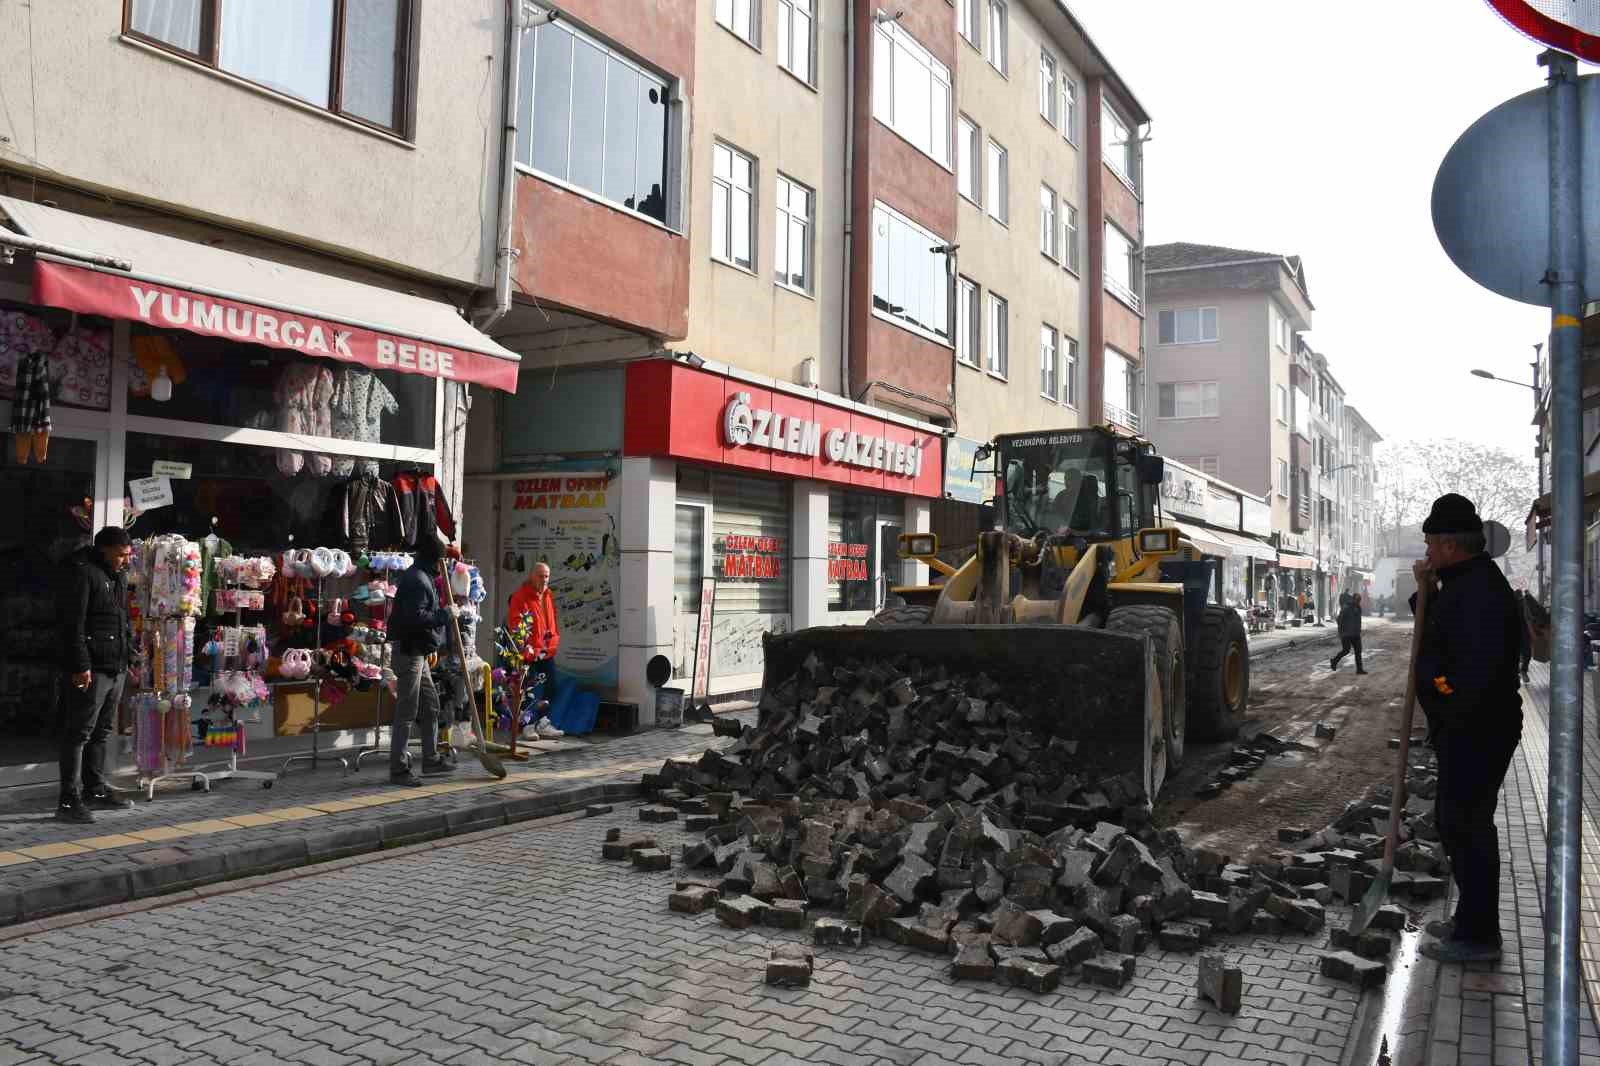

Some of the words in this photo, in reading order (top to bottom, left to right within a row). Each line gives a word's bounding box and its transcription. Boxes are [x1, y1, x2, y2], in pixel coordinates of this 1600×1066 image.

[129, 286, 353, 357] YUMURCAK
[376, 338, 456, 377] BEBE
[724, 391, 820, 456] ÖZLEM
[825, 427, 923, 477] GAZETESİ
[513, 493, 606, 510] MATBAA
[724, 553, 781, 577] MATBAA
